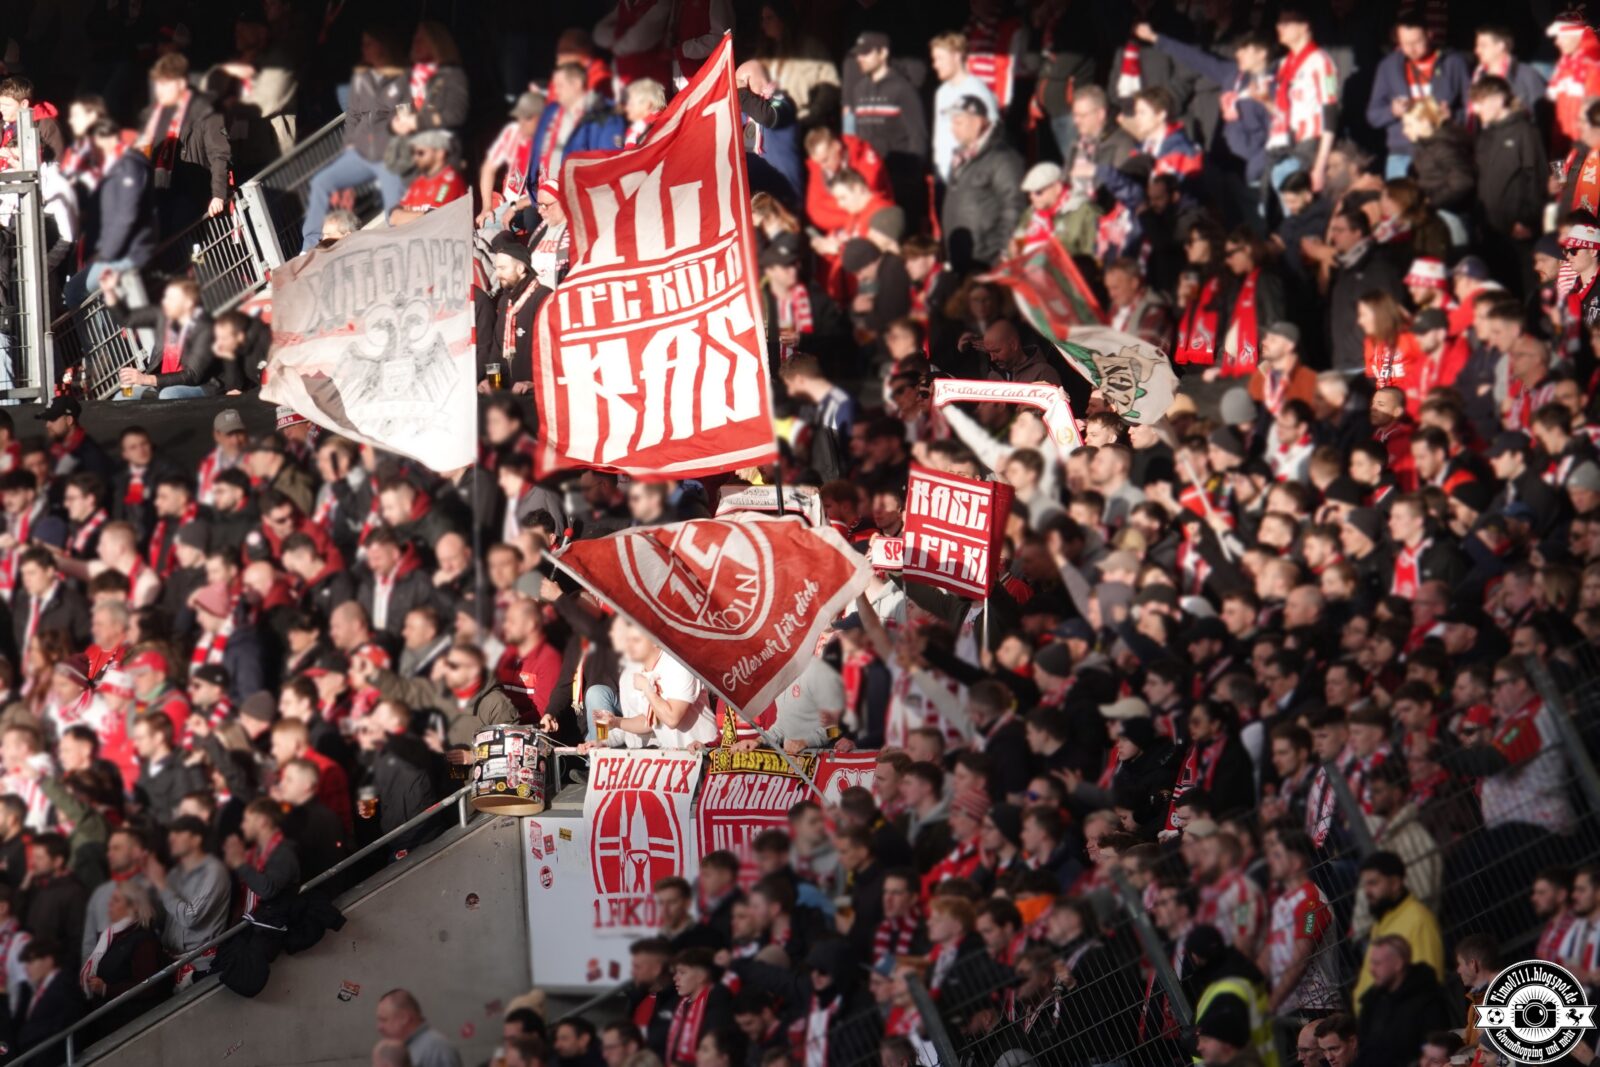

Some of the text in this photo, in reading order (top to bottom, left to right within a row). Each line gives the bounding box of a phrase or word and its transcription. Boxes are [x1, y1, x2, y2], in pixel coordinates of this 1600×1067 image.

[558, 279, 641, 331] 1.FC
[910, 479, 990, 532] RASC
[903, 531, 959, 575] 1.FC
[706, 573, 759, 625] KÖLN
[723, 656, 762, 692] Alles
[773, 612, 807, 650] für
[592, 758, 697, 794] CHAOTIX
